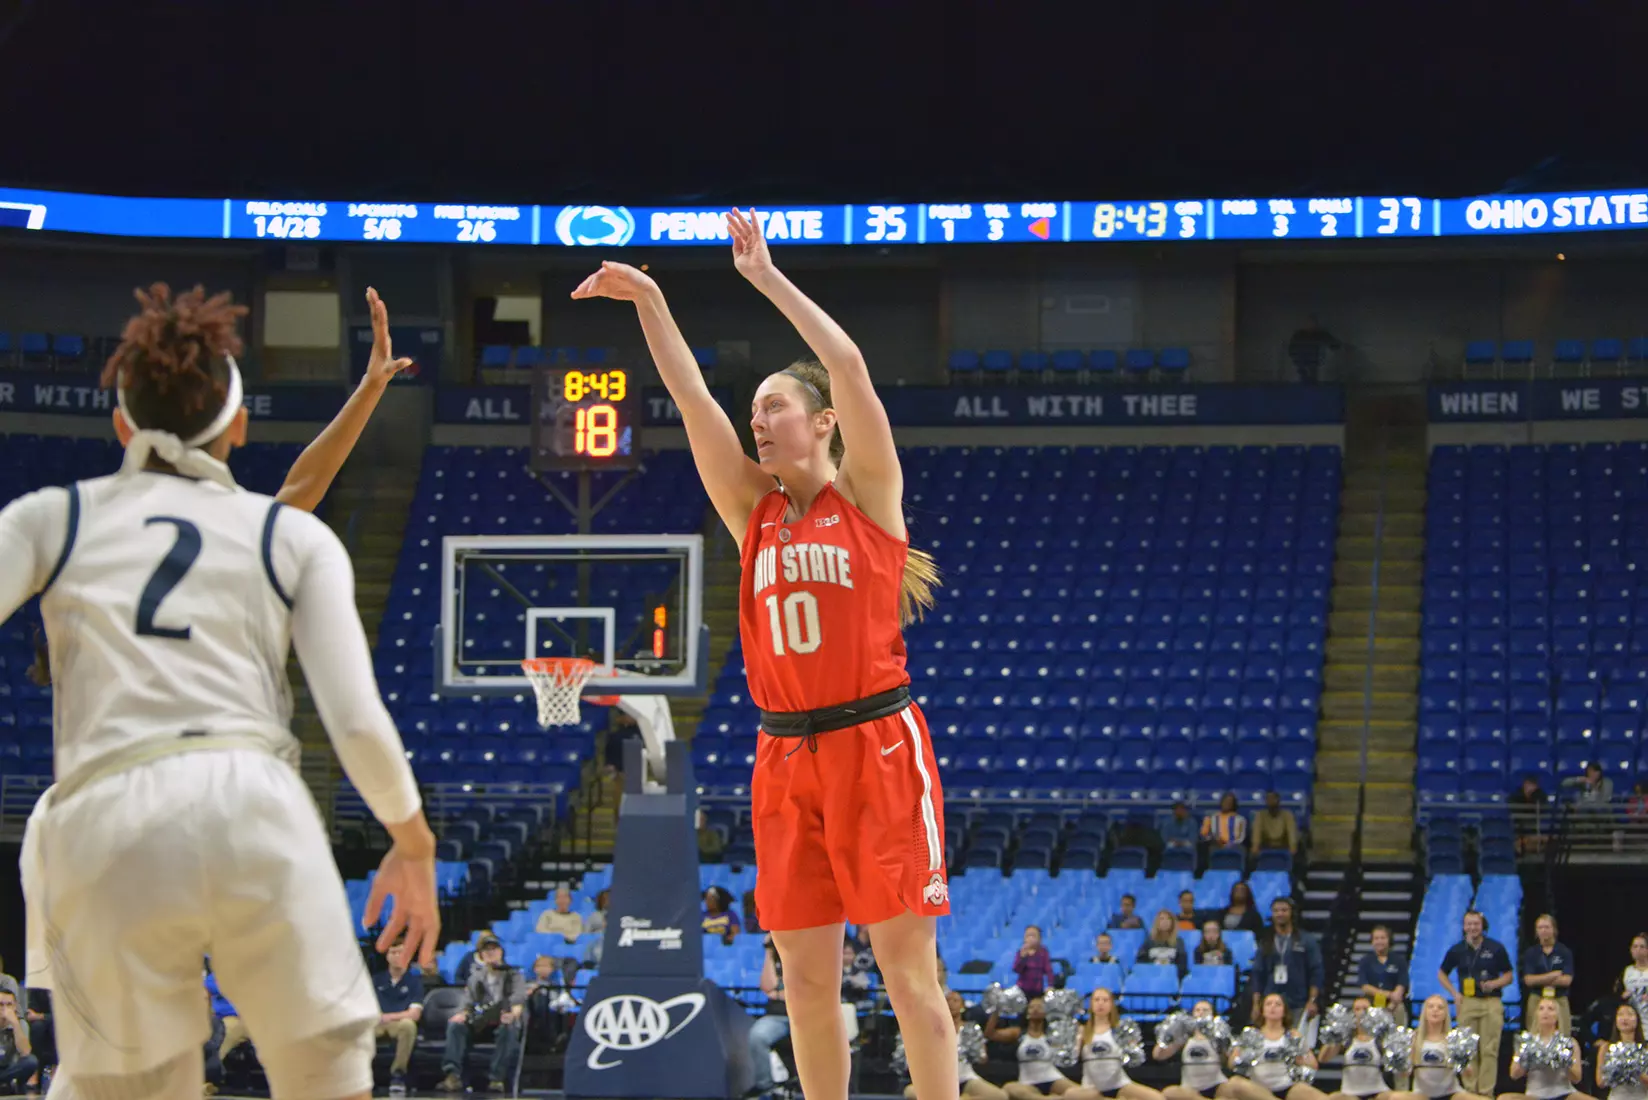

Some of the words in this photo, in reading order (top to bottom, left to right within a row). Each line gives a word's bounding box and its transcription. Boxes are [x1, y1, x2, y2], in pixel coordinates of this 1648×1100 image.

[865, 206, 907, 241] 35
[1093, 202, 1168, 238] 8:43
[1320, 214, 1337, 236] 2
[1377, 198, 1421, 234] 37
[1466, 199, 1548, 230] OHIO
[1552, 194, 1648, 227] STATE
[254, 216, 321, 239] 14/28
[456, 220, 497, 242] 2/6
[651, 212, 731, 240] PENN
[941, 219, 955, 241] 1
[987, 219, 1004, 241] 3
[1179, 216, 1195, 238] 3
[1273, 215, 1289, 237] 3
[35, 384, 110, 409] WITH
[564, 371, 626, 401] 8:43
[465, 399, 520, 419] ALL
[954, 396, 1009, 417] ALL
[1027, 396, 1103, 417] WITH
[1122, 395, 1197, 416] THEE
[1441, 392, 1518, 414] WHEN
[1561, 388, 1600, 410] WE
[575, 405, 617, 456] 18
[135, 516, 203, 640] 2
[781, 542, 854, 590] STATE
[765, 590, 822, 656] 10
[594, 996, 661, 1047] AAA
